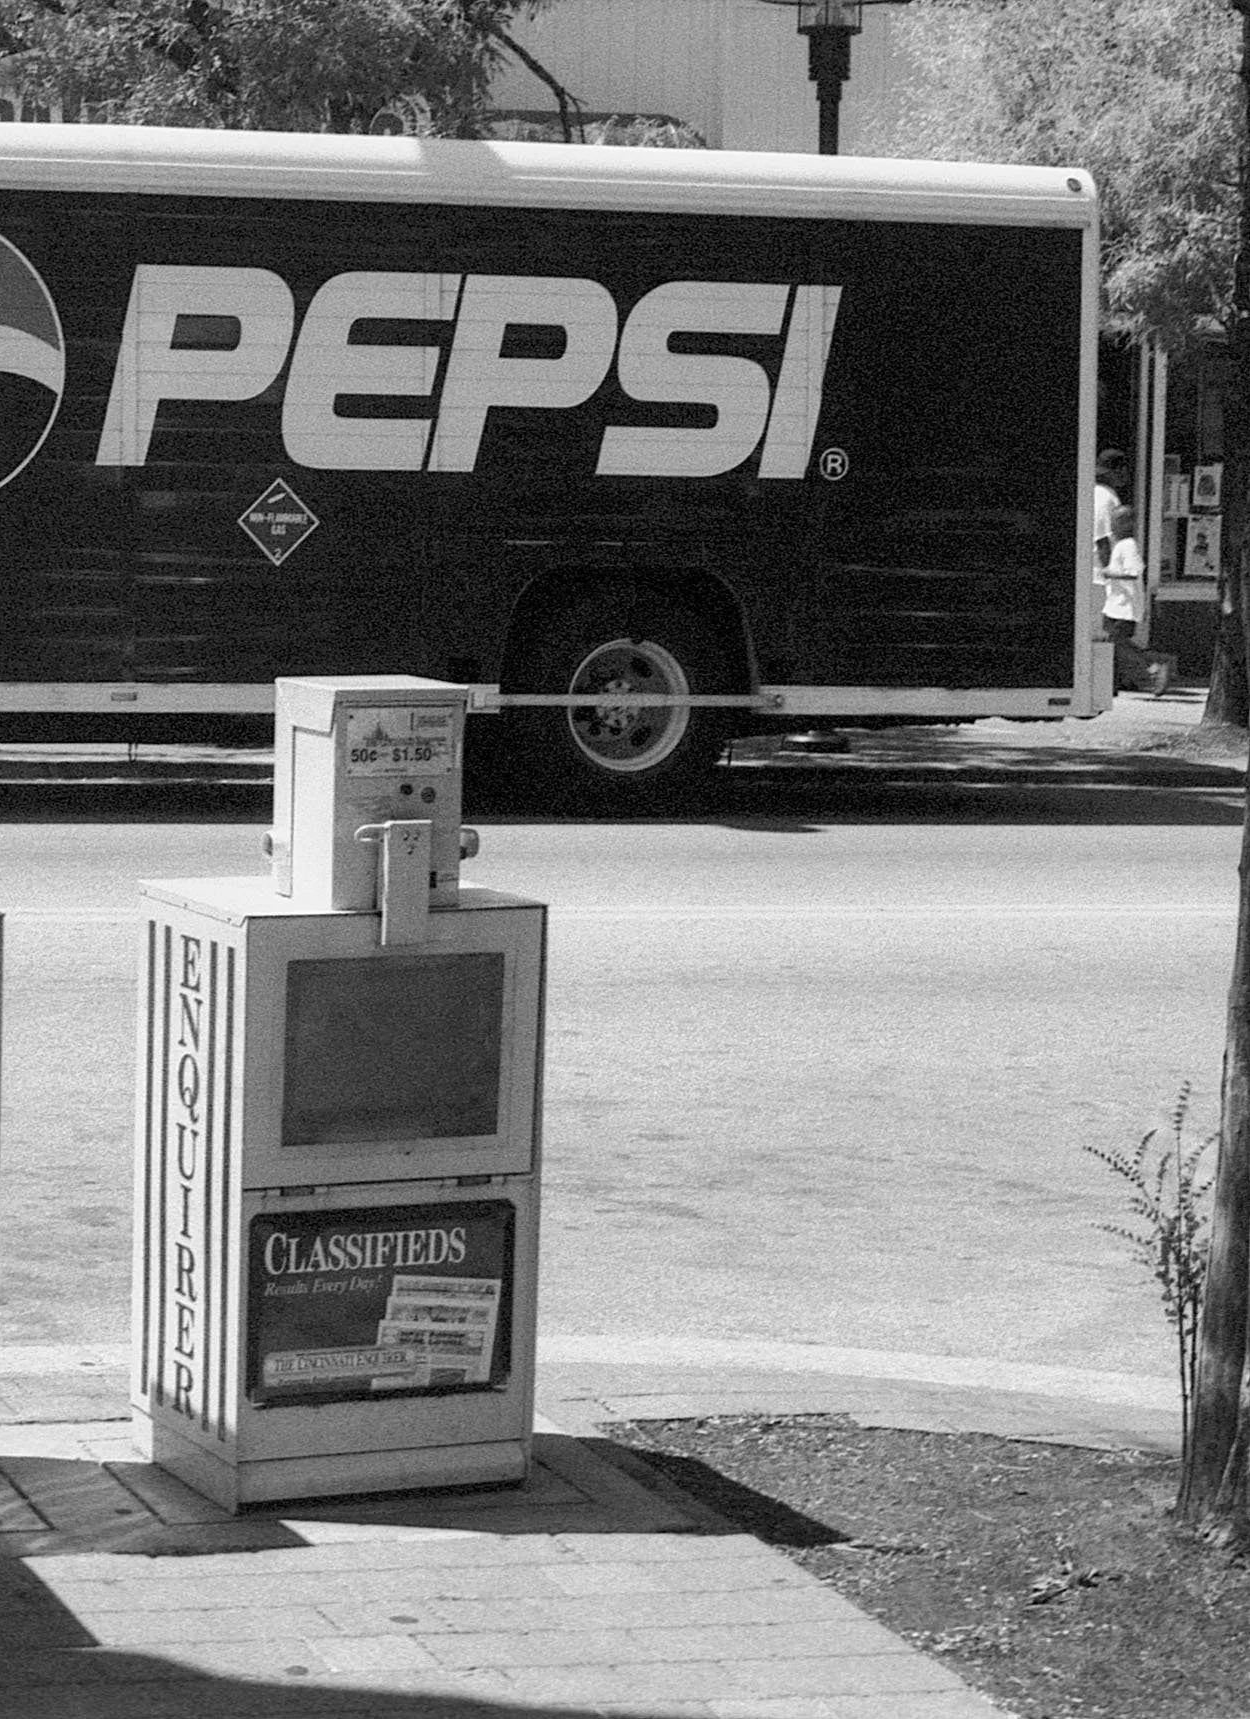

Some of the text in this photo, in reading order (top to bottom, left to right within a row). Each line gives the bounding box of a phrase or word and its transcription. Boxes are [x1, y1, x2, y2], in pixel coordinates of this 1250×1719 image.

[95, 264, 843, 479] PEPSI
[274, 548, 282, 559] 2
[392, 748, 432, 762] $1.50
[171, 933, 204, 1421] ENQUIRER
[264, 1227, 466, 1275] CLASSIFIEDS
[312, 1279, 349, 1296] Every
